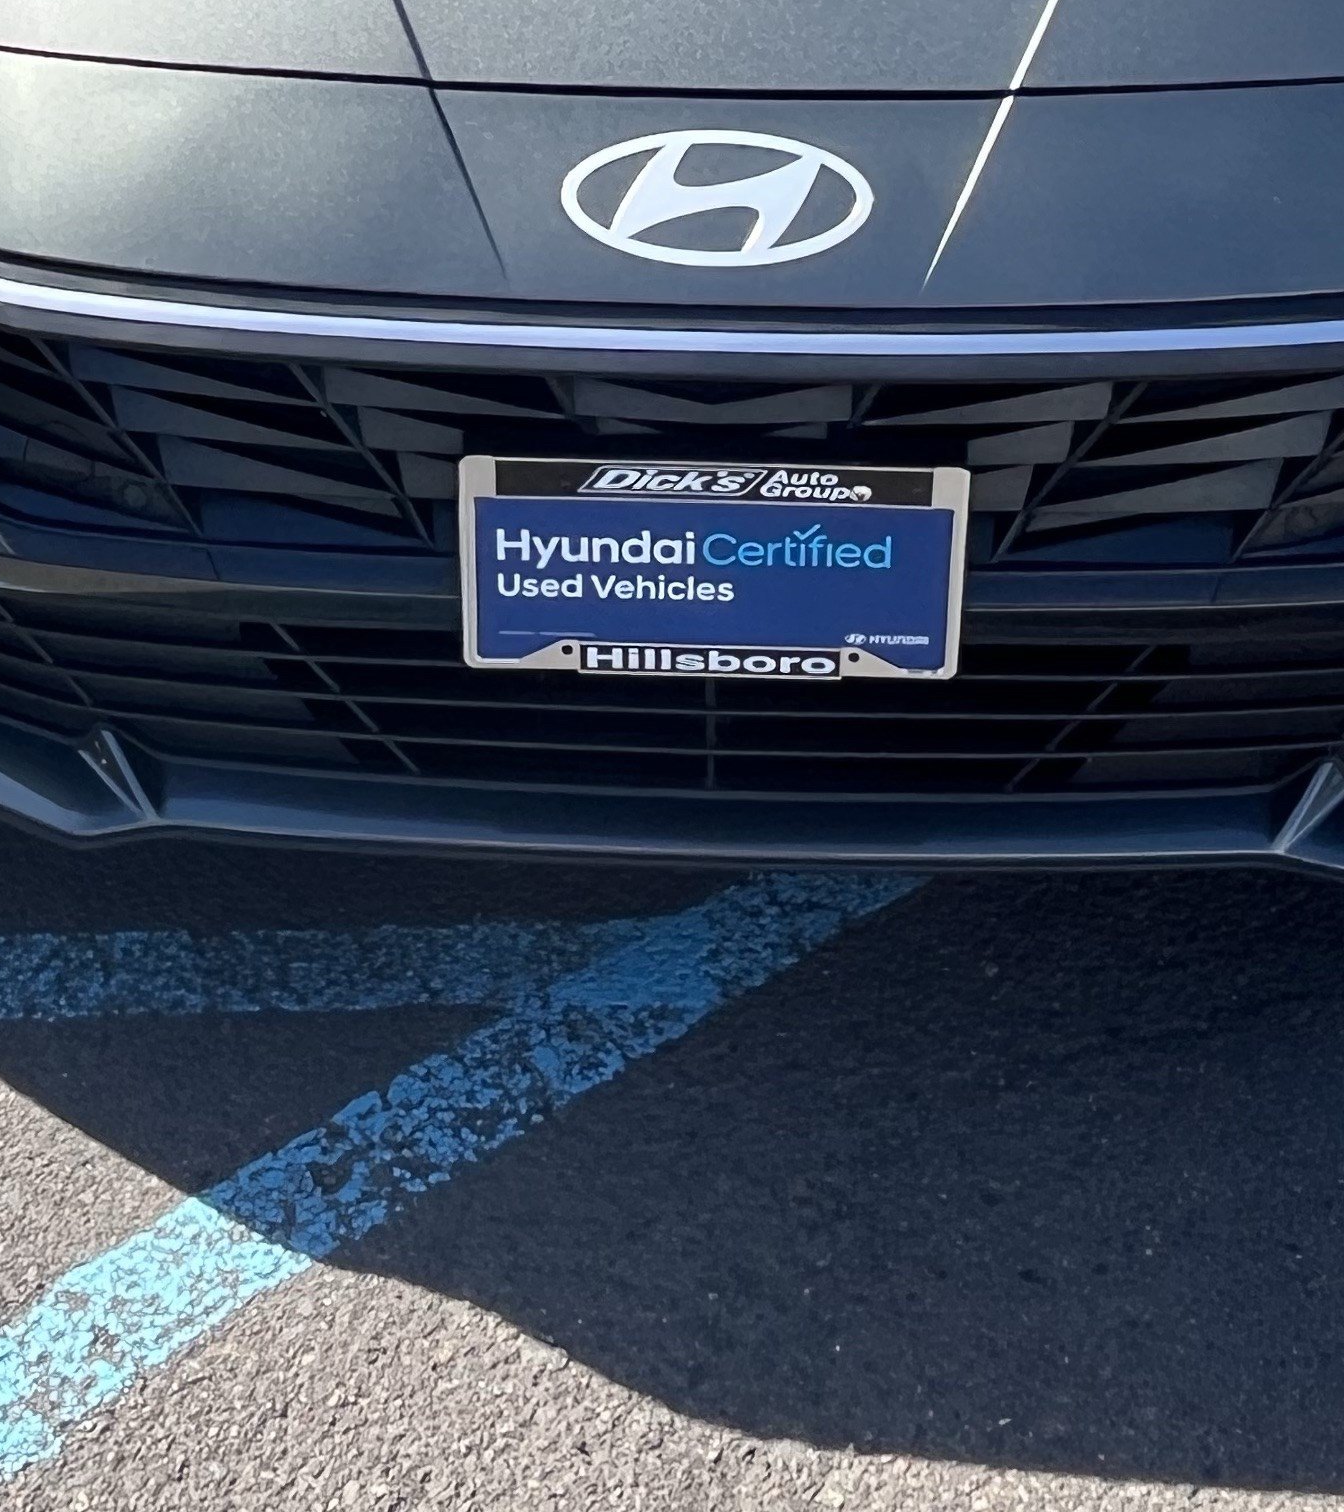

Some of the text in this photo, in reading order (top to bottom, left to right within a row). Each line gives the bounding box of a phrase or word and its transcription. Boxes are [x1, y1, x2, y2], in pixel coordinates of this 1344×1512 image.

[593, 468, 755, 493] Dick's
[765, 469, 840, 487] Auto
[758, 484, 853, 502] Group
[495, 524, 892, 570] Hyundai Certified
[497, 573, 735, 602] Used Vehicles
[586, 646, 836, 674] Hillsboro
